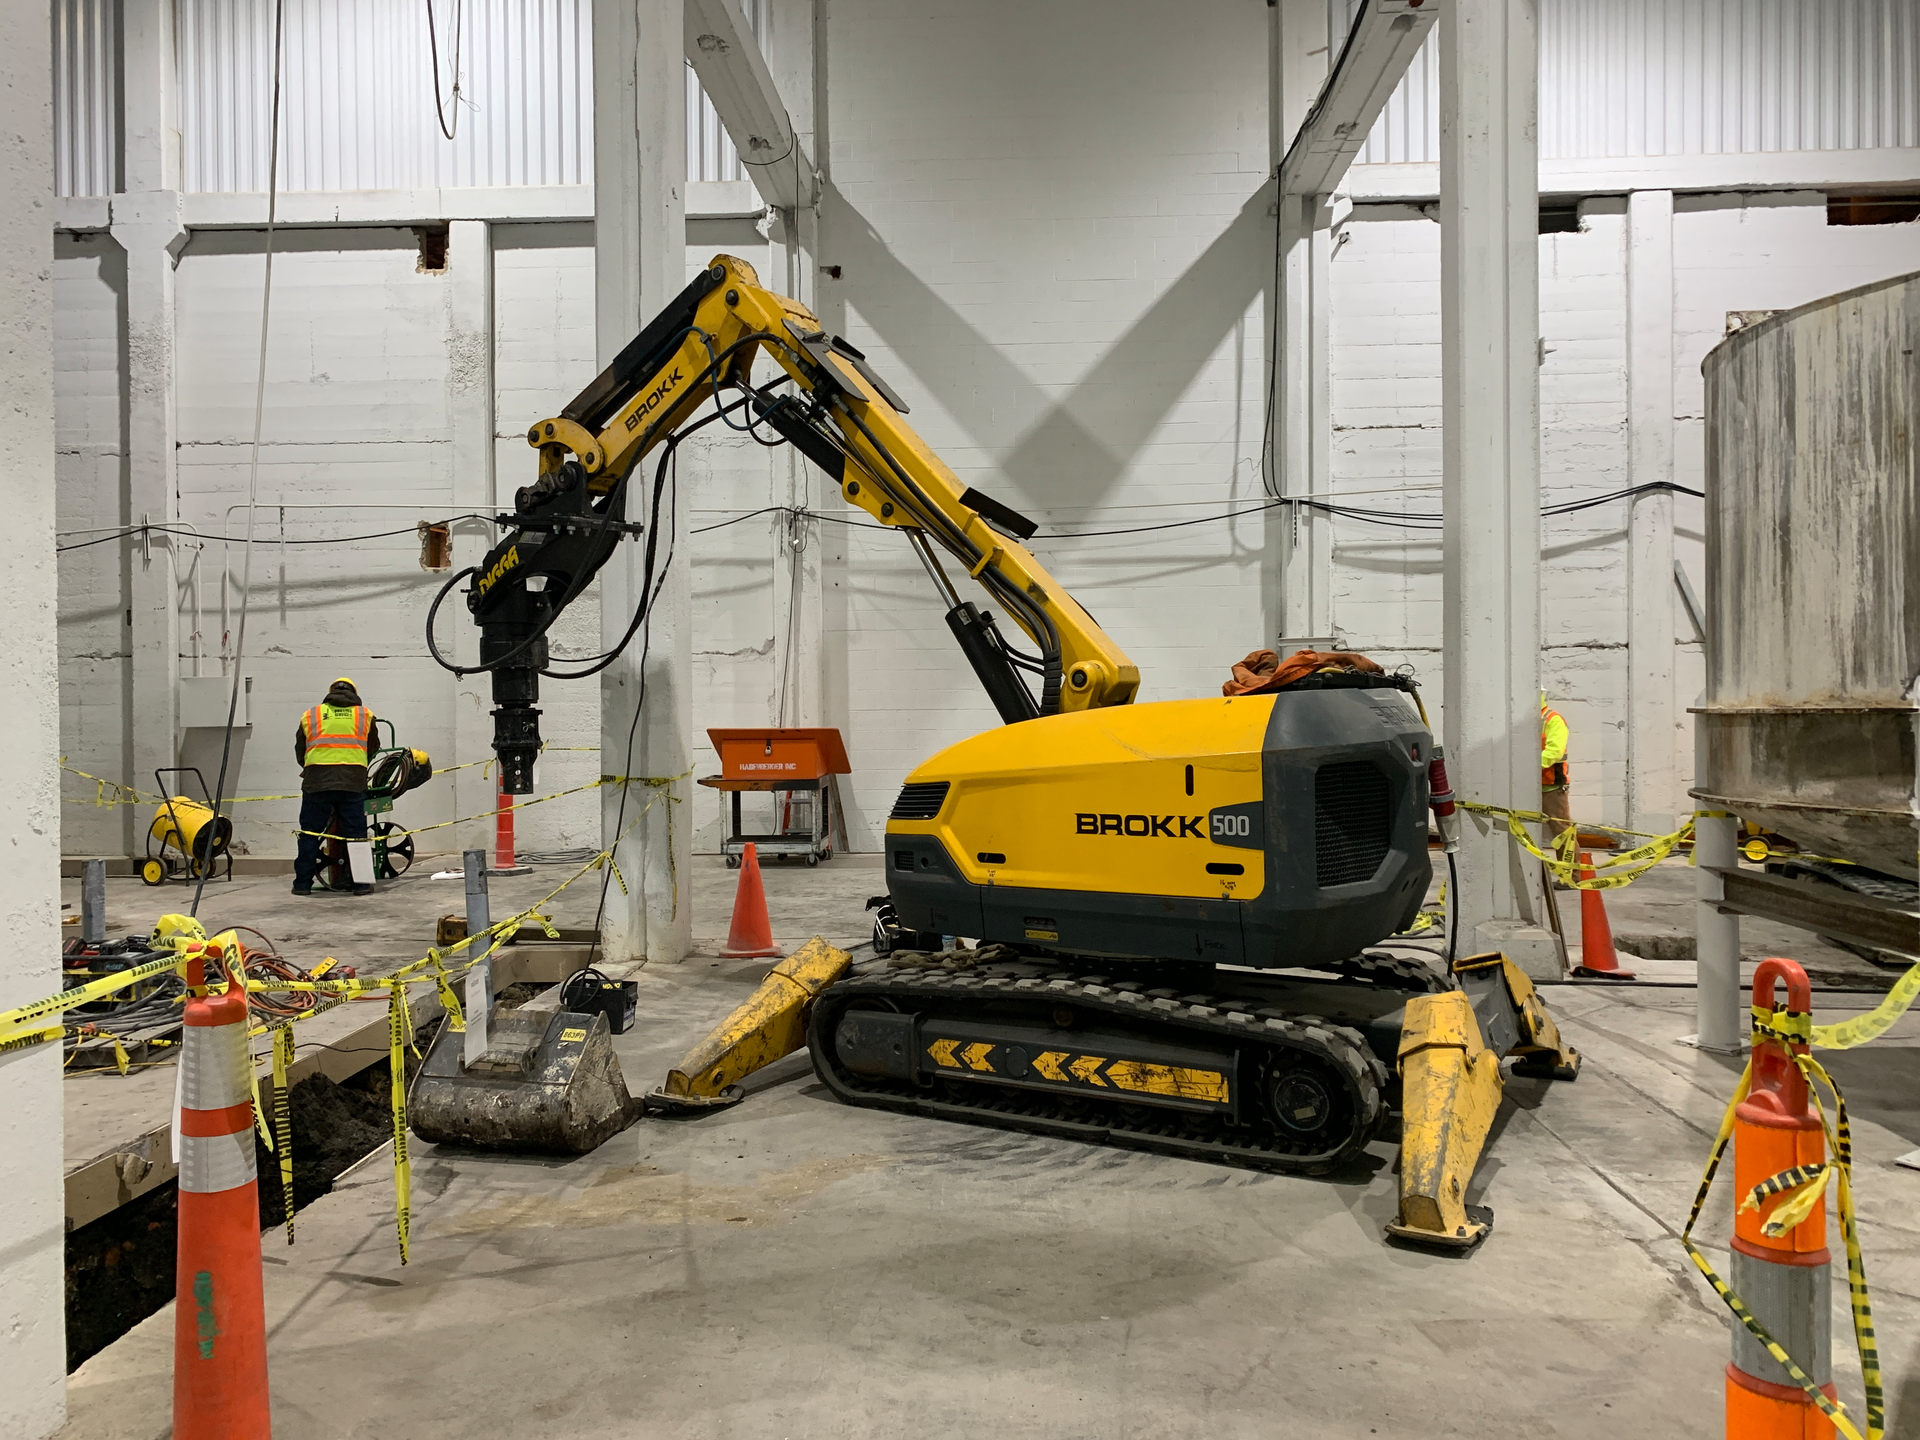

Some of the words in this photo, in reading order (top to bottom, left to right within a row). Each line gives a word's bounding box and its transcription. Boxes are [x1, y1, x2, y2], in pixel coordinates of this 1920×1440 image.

[624, 366, 684, 433] BROKK
[479, 545, 519, 595] DIGGA
[1075, 813, 1207, 838] BROKK
[1213, 815, 1250, 836] 500
